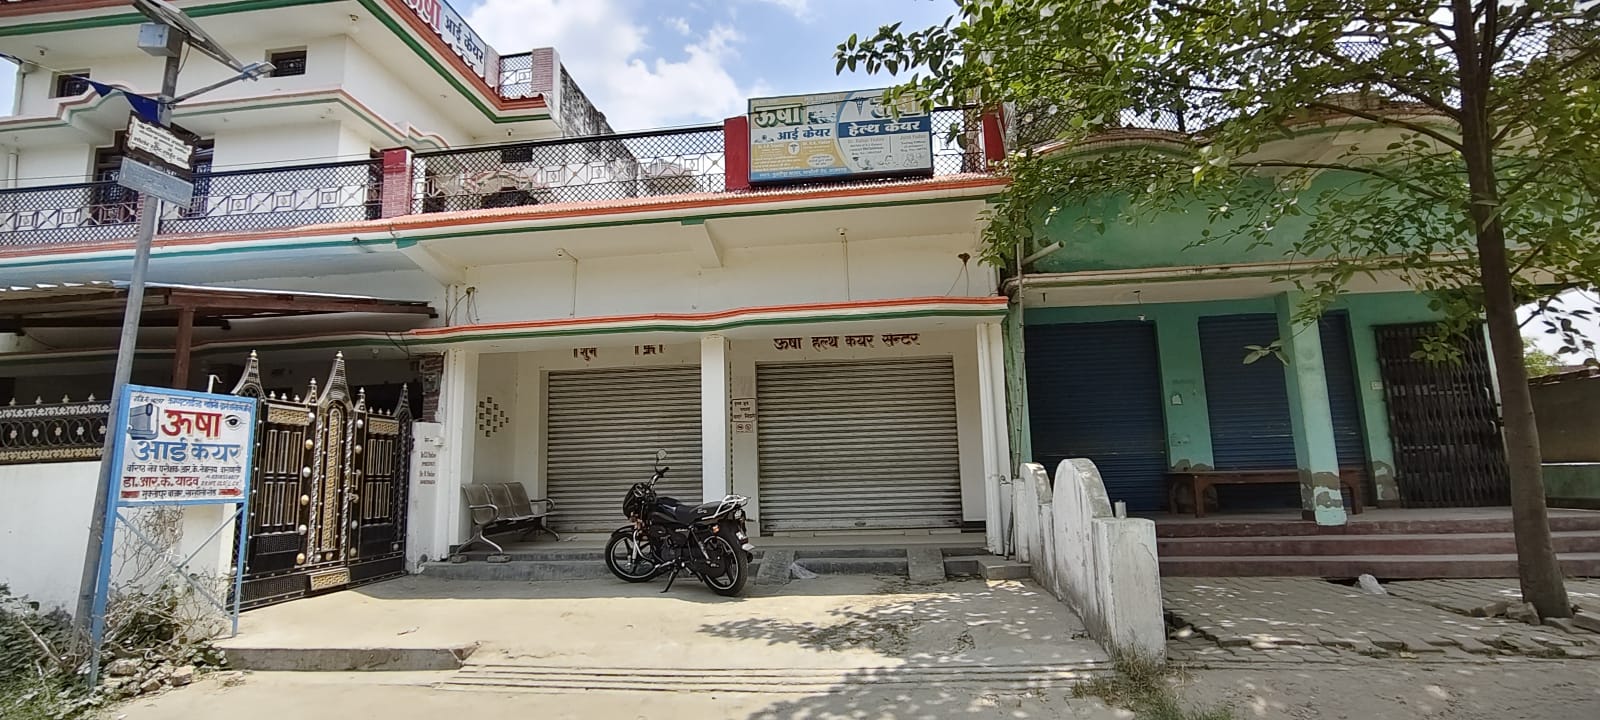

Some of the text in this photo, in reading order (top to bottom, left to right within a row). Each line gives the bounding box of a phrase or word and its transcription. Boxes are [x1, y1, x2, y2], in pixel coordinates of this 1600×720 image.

[445, 15, 462, 43] आई
[464, 32, 484, 64] केयर
[754, 103, 803, 128] ऊषा
[777, 126, 831, 140] आई केयर
[848, 119, 921, 137] हेल्थ केयर
[773, 337, 802, 350] ऊषा
[161, 409, 222, 438] ऊषा
[131, 438, 188, 462] आई
[174, 476, 199, 487] यादव
